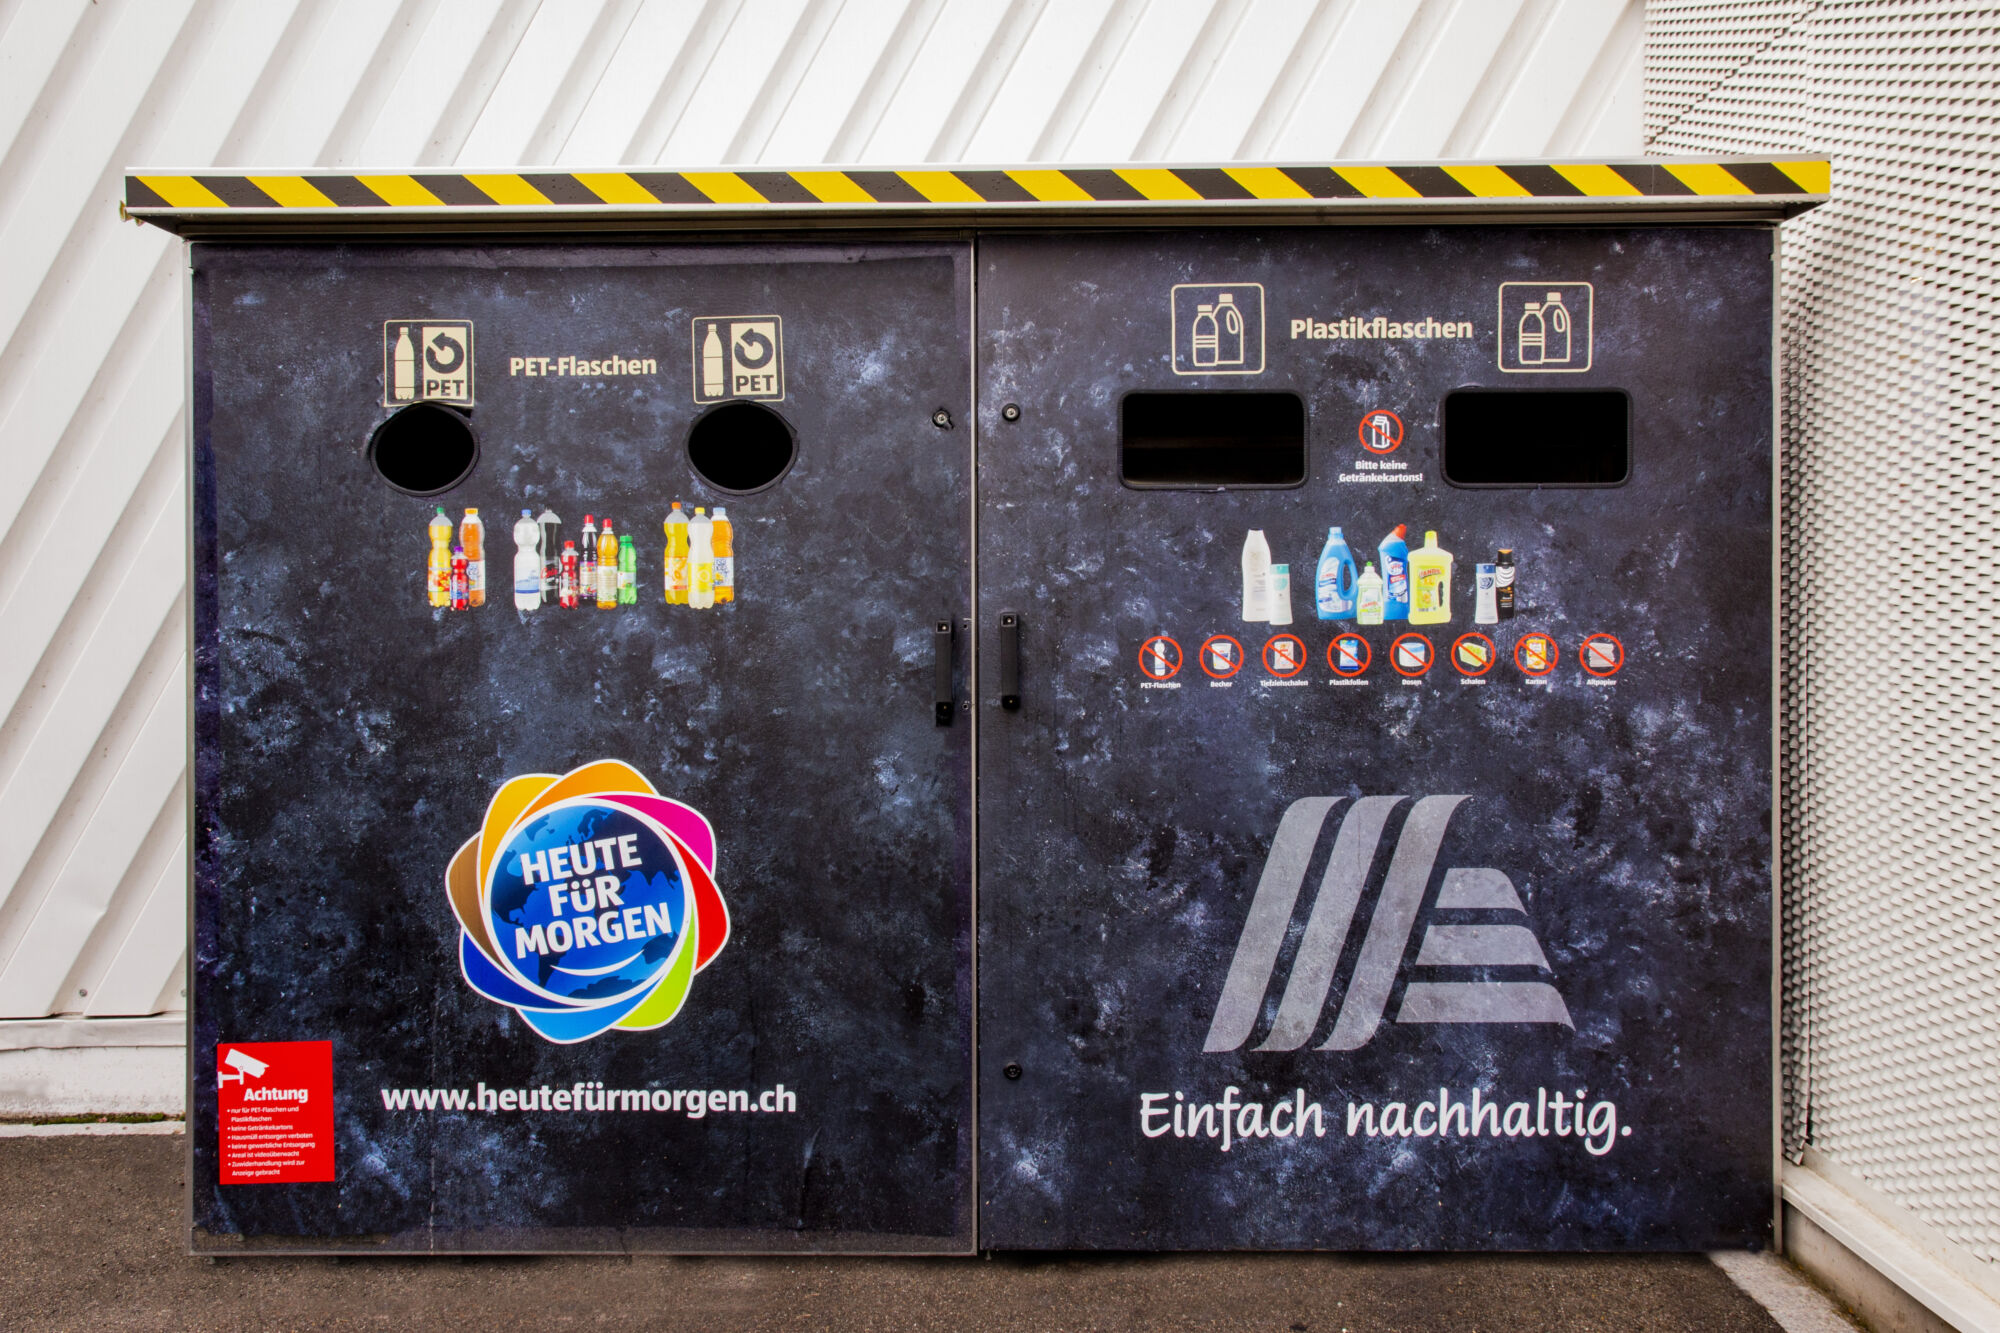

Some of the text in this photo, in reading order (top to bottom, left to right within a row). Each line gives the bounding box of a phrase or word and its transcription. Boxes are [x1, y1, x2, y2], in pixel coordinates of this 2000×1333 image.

[1291, 316, 1473, 340] Plastikflaschen
[510, 355, 657, 376] PET-Flaschen
[426, 379, 465, 396] PET
[735, 374, 774, 392] PET
[1355, 460, 1408, 470] Bitte keine
[1339, 473, 1423, 483] Getränkekartons!
[1402, 678, 1422, 686] Dosen
[520, 833, 642, 885] HEUTE
[548, 875, 624, 917] FÜR
[515, 902, 672, 959] MORGEN
[244, 1086, 308, 1104] Achtung
[381, 1082, 797, 1118] www.heutefürmorgen.ch
[1140, 1086, 1632, 1156] Einfach nachhaltig.
